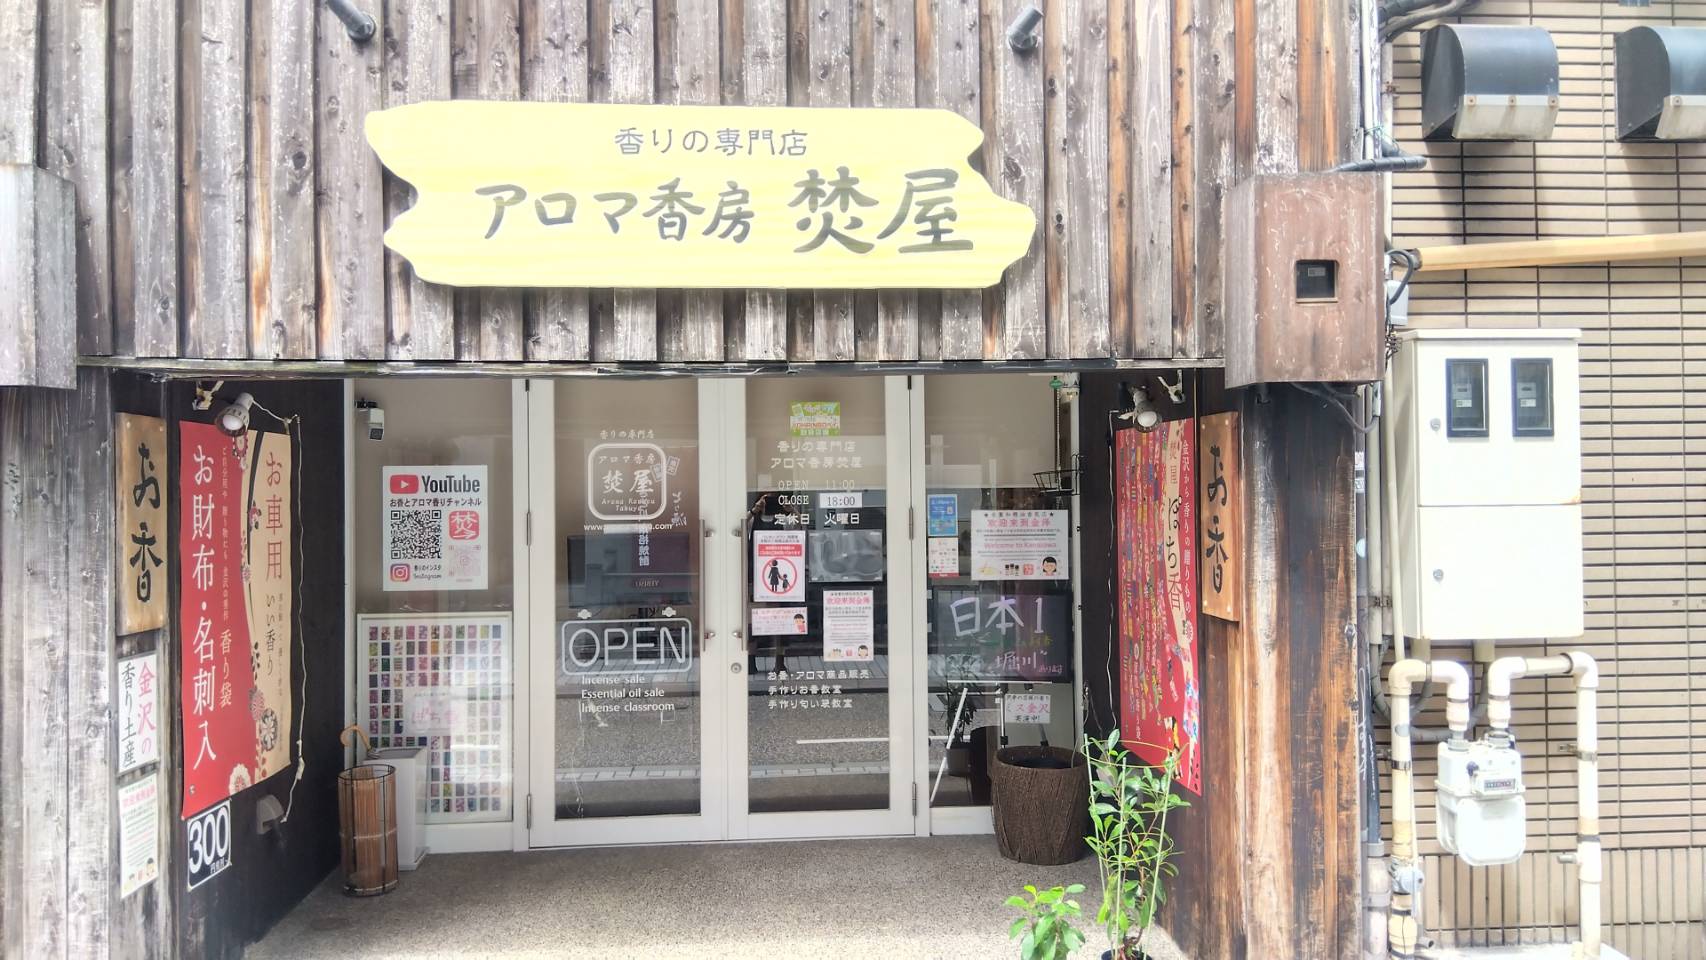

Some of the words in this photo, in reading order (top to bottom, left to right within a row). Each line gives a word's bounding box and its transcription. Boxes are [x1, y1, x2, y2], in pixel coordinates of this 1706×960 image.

[614, 128, 808, 157] 香りの専門店
[475, 177, 756, 243] アロマ香房
[788, 166, 973, 253] 焚屋
[600, 429, 656, 440] 香りの専門店
[777, 440, 856, 452] 香りの専門店
[598, 453, 657, 465] アロマ香房
[422, 474, 480, 493] YouTube
[602, 470, 654, 494] 焚屋
[778, 480, 809, 490] OPEN
[826, 480, 855, 489] 11:00
[390, 497, 481, 507] お香とアロマ香りチャンネル
[778, 495, 809, 505] CLOSE
[827, 496, 856, 506] 18:00
[130, 443, 163, 602] お香
[266, 452, 283, 581] お車用
[774, 513, 810, 525] 定休日
[824, 512, 860, 525] 火曜日
[1206, 444, 1228, 594] お香
[192, 445, 217, 770] お財布・名刺入
[265, 595, 277, 677] いい香り
[568, 626, 686, 667] OPEN
[220, 629, 232, 708] 香り袋
[582, 675, 619, 685] Incense
[624, 675, 645, 684] sale
[581, 688, 626, 699] Essential
[628, 687, 641, 698] oil
[644, 688, 665, 697] sale
[768, 685, 842, 695] 手作りお香教室
[121, 662, 137, 767] 香り土産
[137, 661, 156, 754] 金沢の
[581, 703, 620, 713] Incense
[624, 702, 675, 712] classroom
[189, 806, 229, 874] 300
